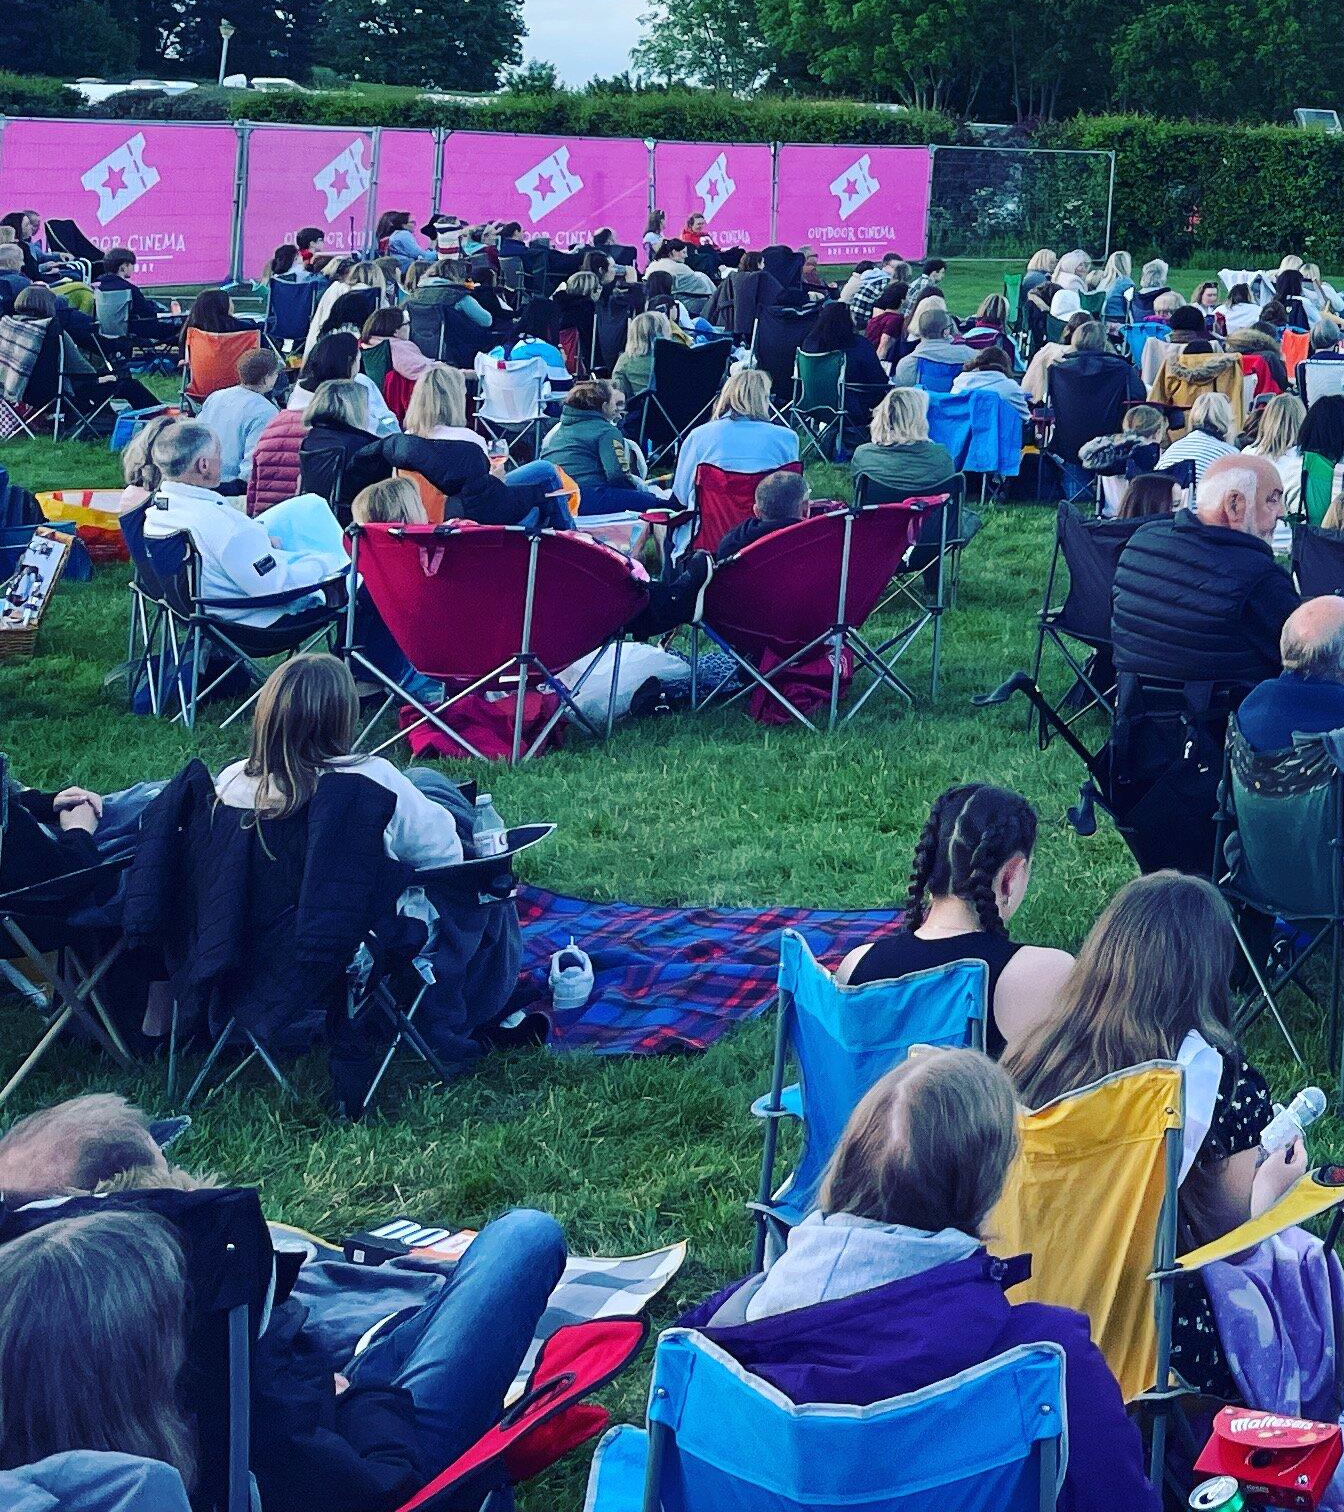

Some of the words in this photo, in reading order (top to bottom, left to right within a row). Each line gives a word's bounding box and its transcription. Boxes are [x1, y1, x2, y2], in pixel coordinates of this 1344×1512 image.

[807, 226, 856, 241] OUTDOOR
[857, 224, 896, 240] CINEMA
[126, 232, 187, 253] CINEMA
